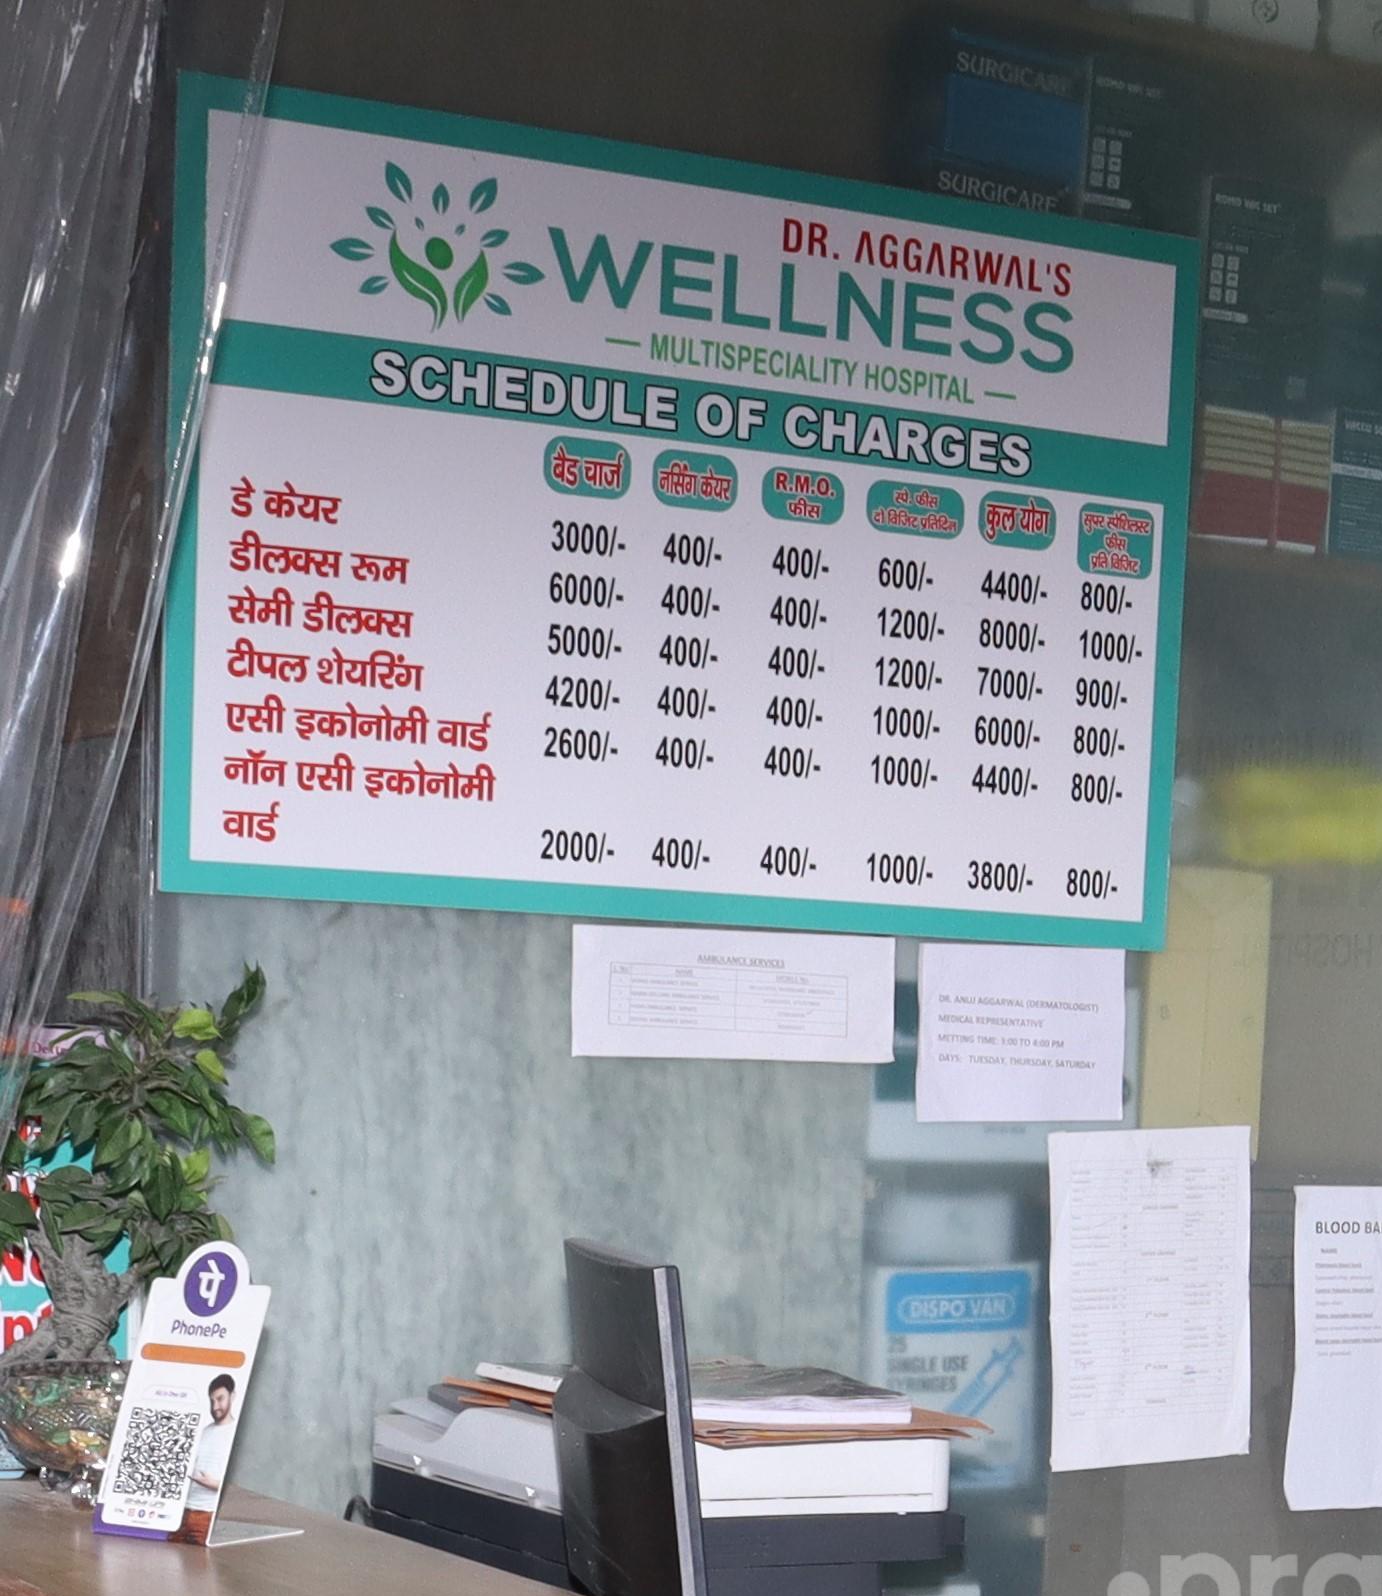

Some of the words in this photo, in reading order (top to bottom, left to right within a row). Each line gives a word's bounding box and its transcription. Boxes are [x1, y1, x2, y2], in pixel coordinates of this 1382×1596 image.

[937, 170, 1060, 212] SURGICARE
[782, 218, 841, 260] DR.
[855, 231, 1072, 296] AGGARWAL'S
[548, 227, 1074, 373] WELLNESS
[650, 333, 859, 388] MULTISPECIALITY
[864, 364, 975, 403] HOSPITAL
[370, 349, 679, 431] SCHEDULE
[695, 384, 767, 440] OF
[783, 406, 1033, 476] CHARGES
[584, 452, 623, 490] चार्ज
[700, 468, 732, 500] केयर
[775, 472, 835, 497] R.M.O.
[231, 478, 256, 518] डे
[263, 483, 341, 525] केयर
[788, 499, 821, 518] फीस
[986, 503, 1016, 539] कुल
[1020, 500, 1050, 534] योग
[230, 529, 343, 578] डीलक्स
[352, 553, 410, 582] रूम
[551, 519, 626, 557] 3000/-
[662, 532, 722, 568] 400/-
[772, 545, 830, 580] 400/-
[878, 557, 934, 592] 600/-
[980, 569, 1048, 605] 4400/-
[1080, 581, 1133, 615] 800/-
[229, 586, 295, 626] सेमी
[303, 591, 414, 639] डीलक्स
[549, 571, 624, 609] 6000/-
[660, 583, 720, 619] 400/-
[769, 595, 827, 630] 400/-
[877, 607, 945, 642] 1200/-
[979, 617, 1045, 653] 8000/-
[1079, 629, 1143, 664] 1000/-
[227, 636, 310, 684] टीपल
[317, 648, 424, 690] शेयरिंग
[547, 623, 622, 660] 5000/-
[659, 634, 718, 669] 400/-
[767, 645, 825, 679] 400/-
[875, 656, 943, 691] 1200/-
[977, 666, 1043, 701] 7000/-
[1076, 677, 1128, 710] 900/-
[226, 693, 286, 733] एसी
[296, 703, 430, 744] इकोनोमी
[437, 713, 491, 752] वार्ड
[545, 675, 620, 711] 4200/-
[657, 685, 716, 719] 400/-
[766, 695, 823, 729] 400/-
[873, 705, 940, 740] 1000/-
[974, 715, 1040, 750] 6000/-
[1073, 725, 1125, 757] 800/-
[223, 749, 287, 785] नॉन
[295, 751, 357, 792] एसी
[365, 761, 496, 801] इकोनोमी
[544, 726, 618, 762] 2600/-
[655, 736, 714, 769] 400/-
[764, 745, 821, 778] 400/-
[871, 755, 938, 788] 1000/-
[971, 764, 1038, 797] 4400/-
[1071, 773, 1123, 805] 800/-
[223, 801, 279, 843] वार्ड
[540, 829, 615, 863] 2000/-
[651, 837, 710, 870] 400/-
[760, 845, 817, 877] 400/-
[867, 853, 933, 885] 1000/-
[967, 860, 1033, 892] 3800/-
[1066, 868, 1118, 899] 800/-
[1315, 1221, 1360, 1234] BLOOD
[171, 1319, 227, 1339] PhonePe
[910, 1301, 964, 1318] DISPO
[972, 1299, 1005, 1316] VAN
[942, 1355, 968, 1372] USE
